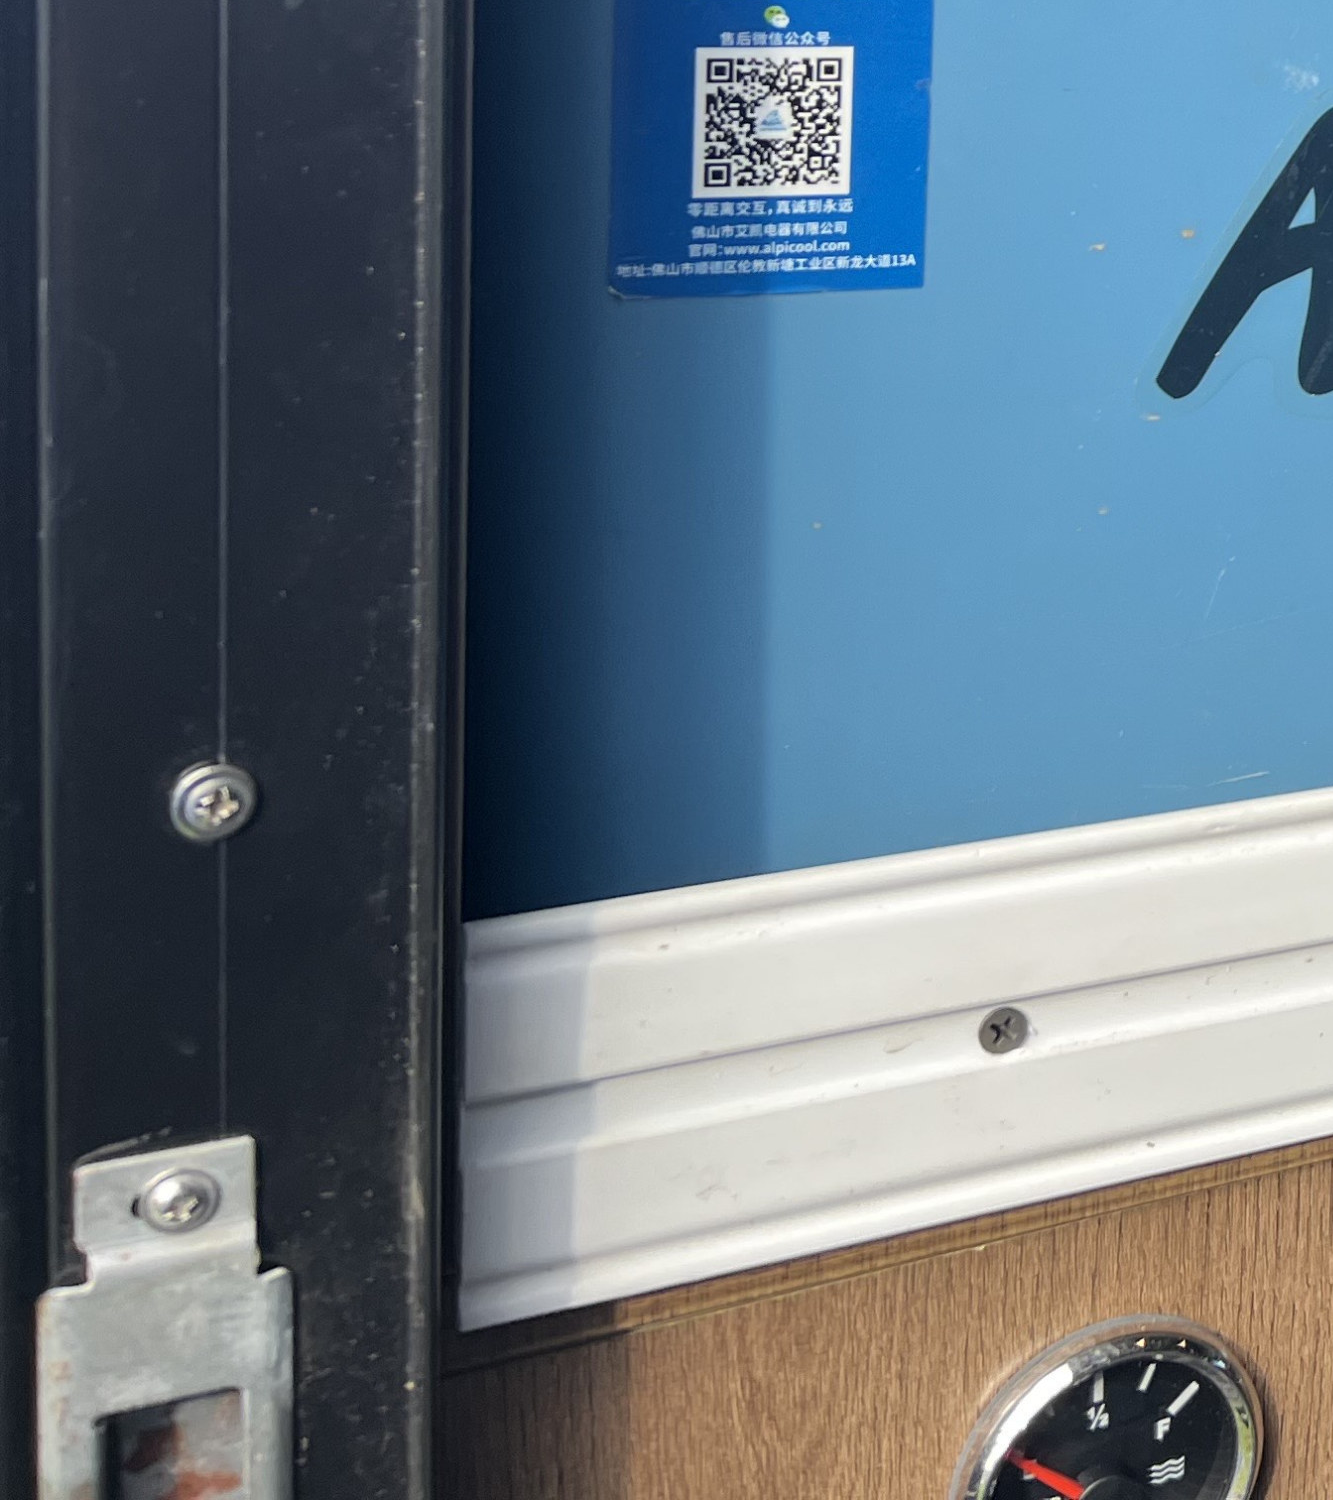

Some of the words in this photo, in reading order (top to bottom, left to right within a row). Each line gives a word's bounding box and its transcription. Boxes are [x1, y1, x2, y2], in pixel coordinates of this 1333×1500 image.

[720, 31, 831, 46] 售后微信公众号
[1153, 1417, 1172, 1442] F
